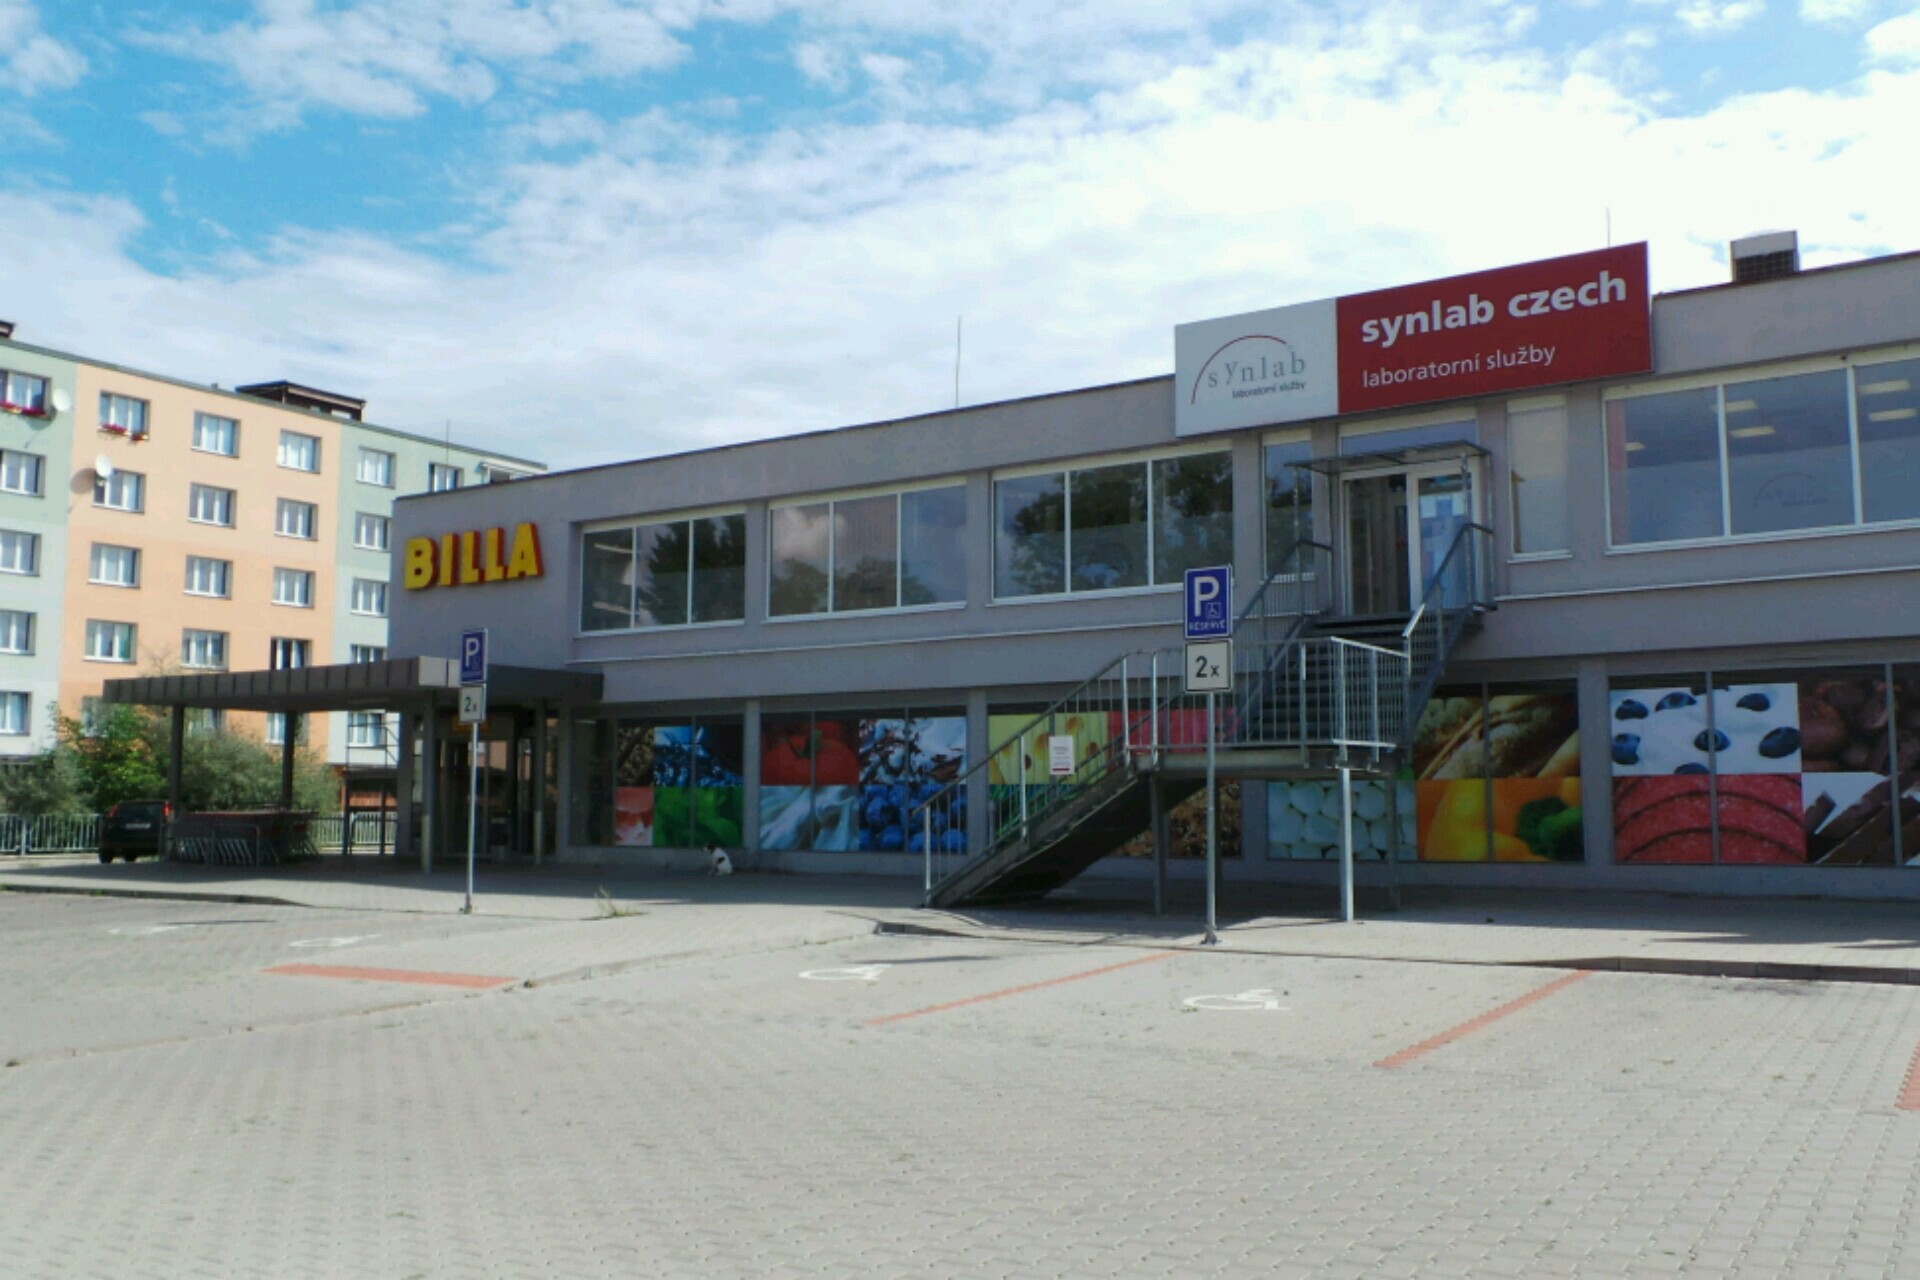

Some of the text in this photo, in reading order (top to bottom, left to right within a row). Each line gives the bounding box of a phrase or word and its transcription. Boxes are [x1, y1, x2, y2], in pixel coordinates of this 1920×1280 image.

[1362, 270, 1626, 347] synlab czech
[1208, 351, 1305, 388] synlab
[1362, 344, 1556, 387] laboratorní služby
[404, 522, 544, 590] BILLA
[1194, 576, 1219, 617] P
[466, 637, 479, 667] P
